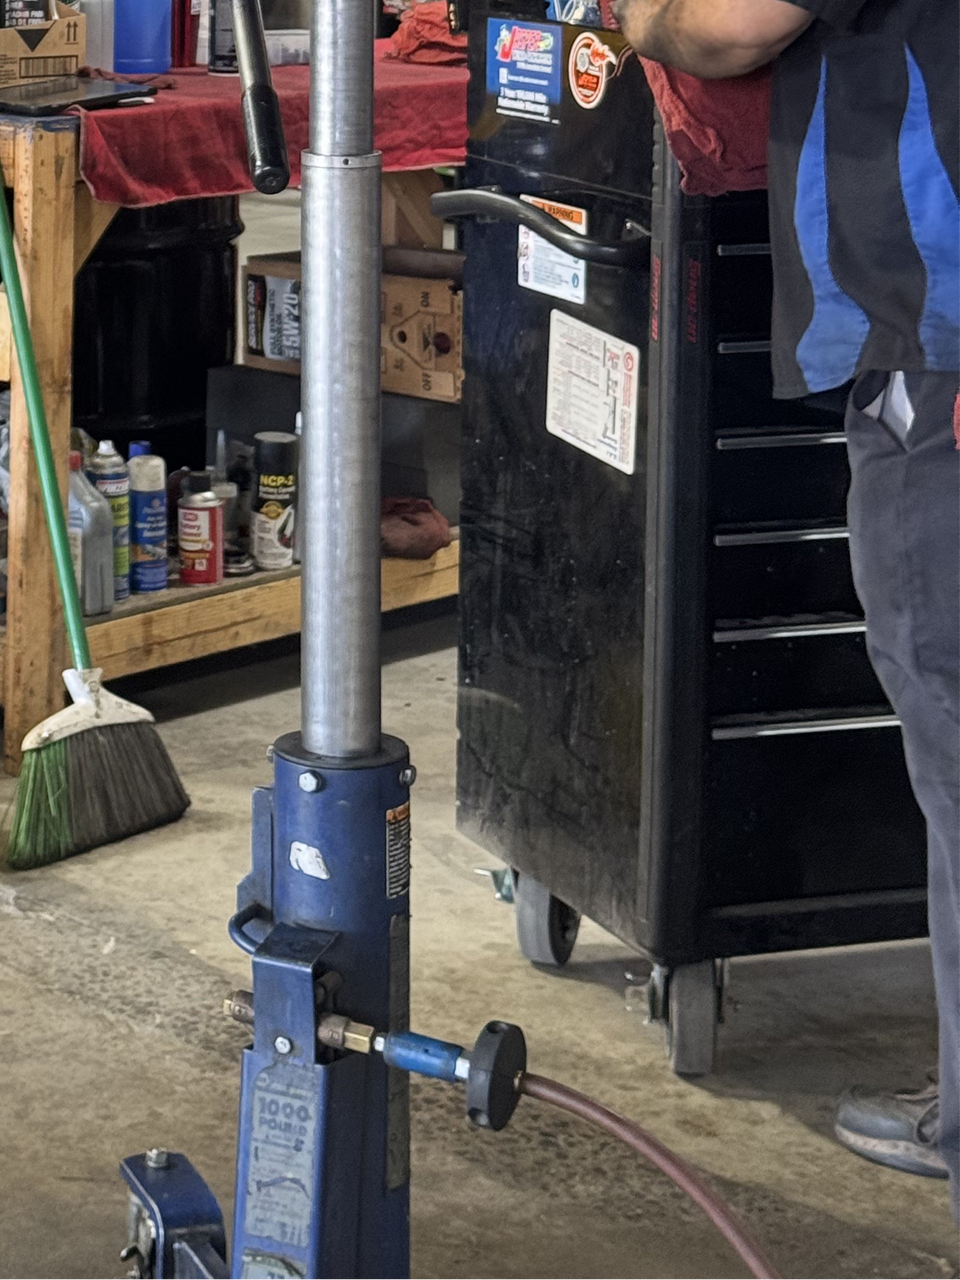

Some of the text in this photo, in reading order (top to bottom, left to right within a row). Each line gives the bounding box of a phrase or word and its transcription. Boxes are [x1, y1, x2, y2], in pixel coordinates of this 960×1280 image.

[420, 291, 430, 308] ON
[422, 372, 432, 391] OFF
[258, 1095, 309, 1122] 1000
